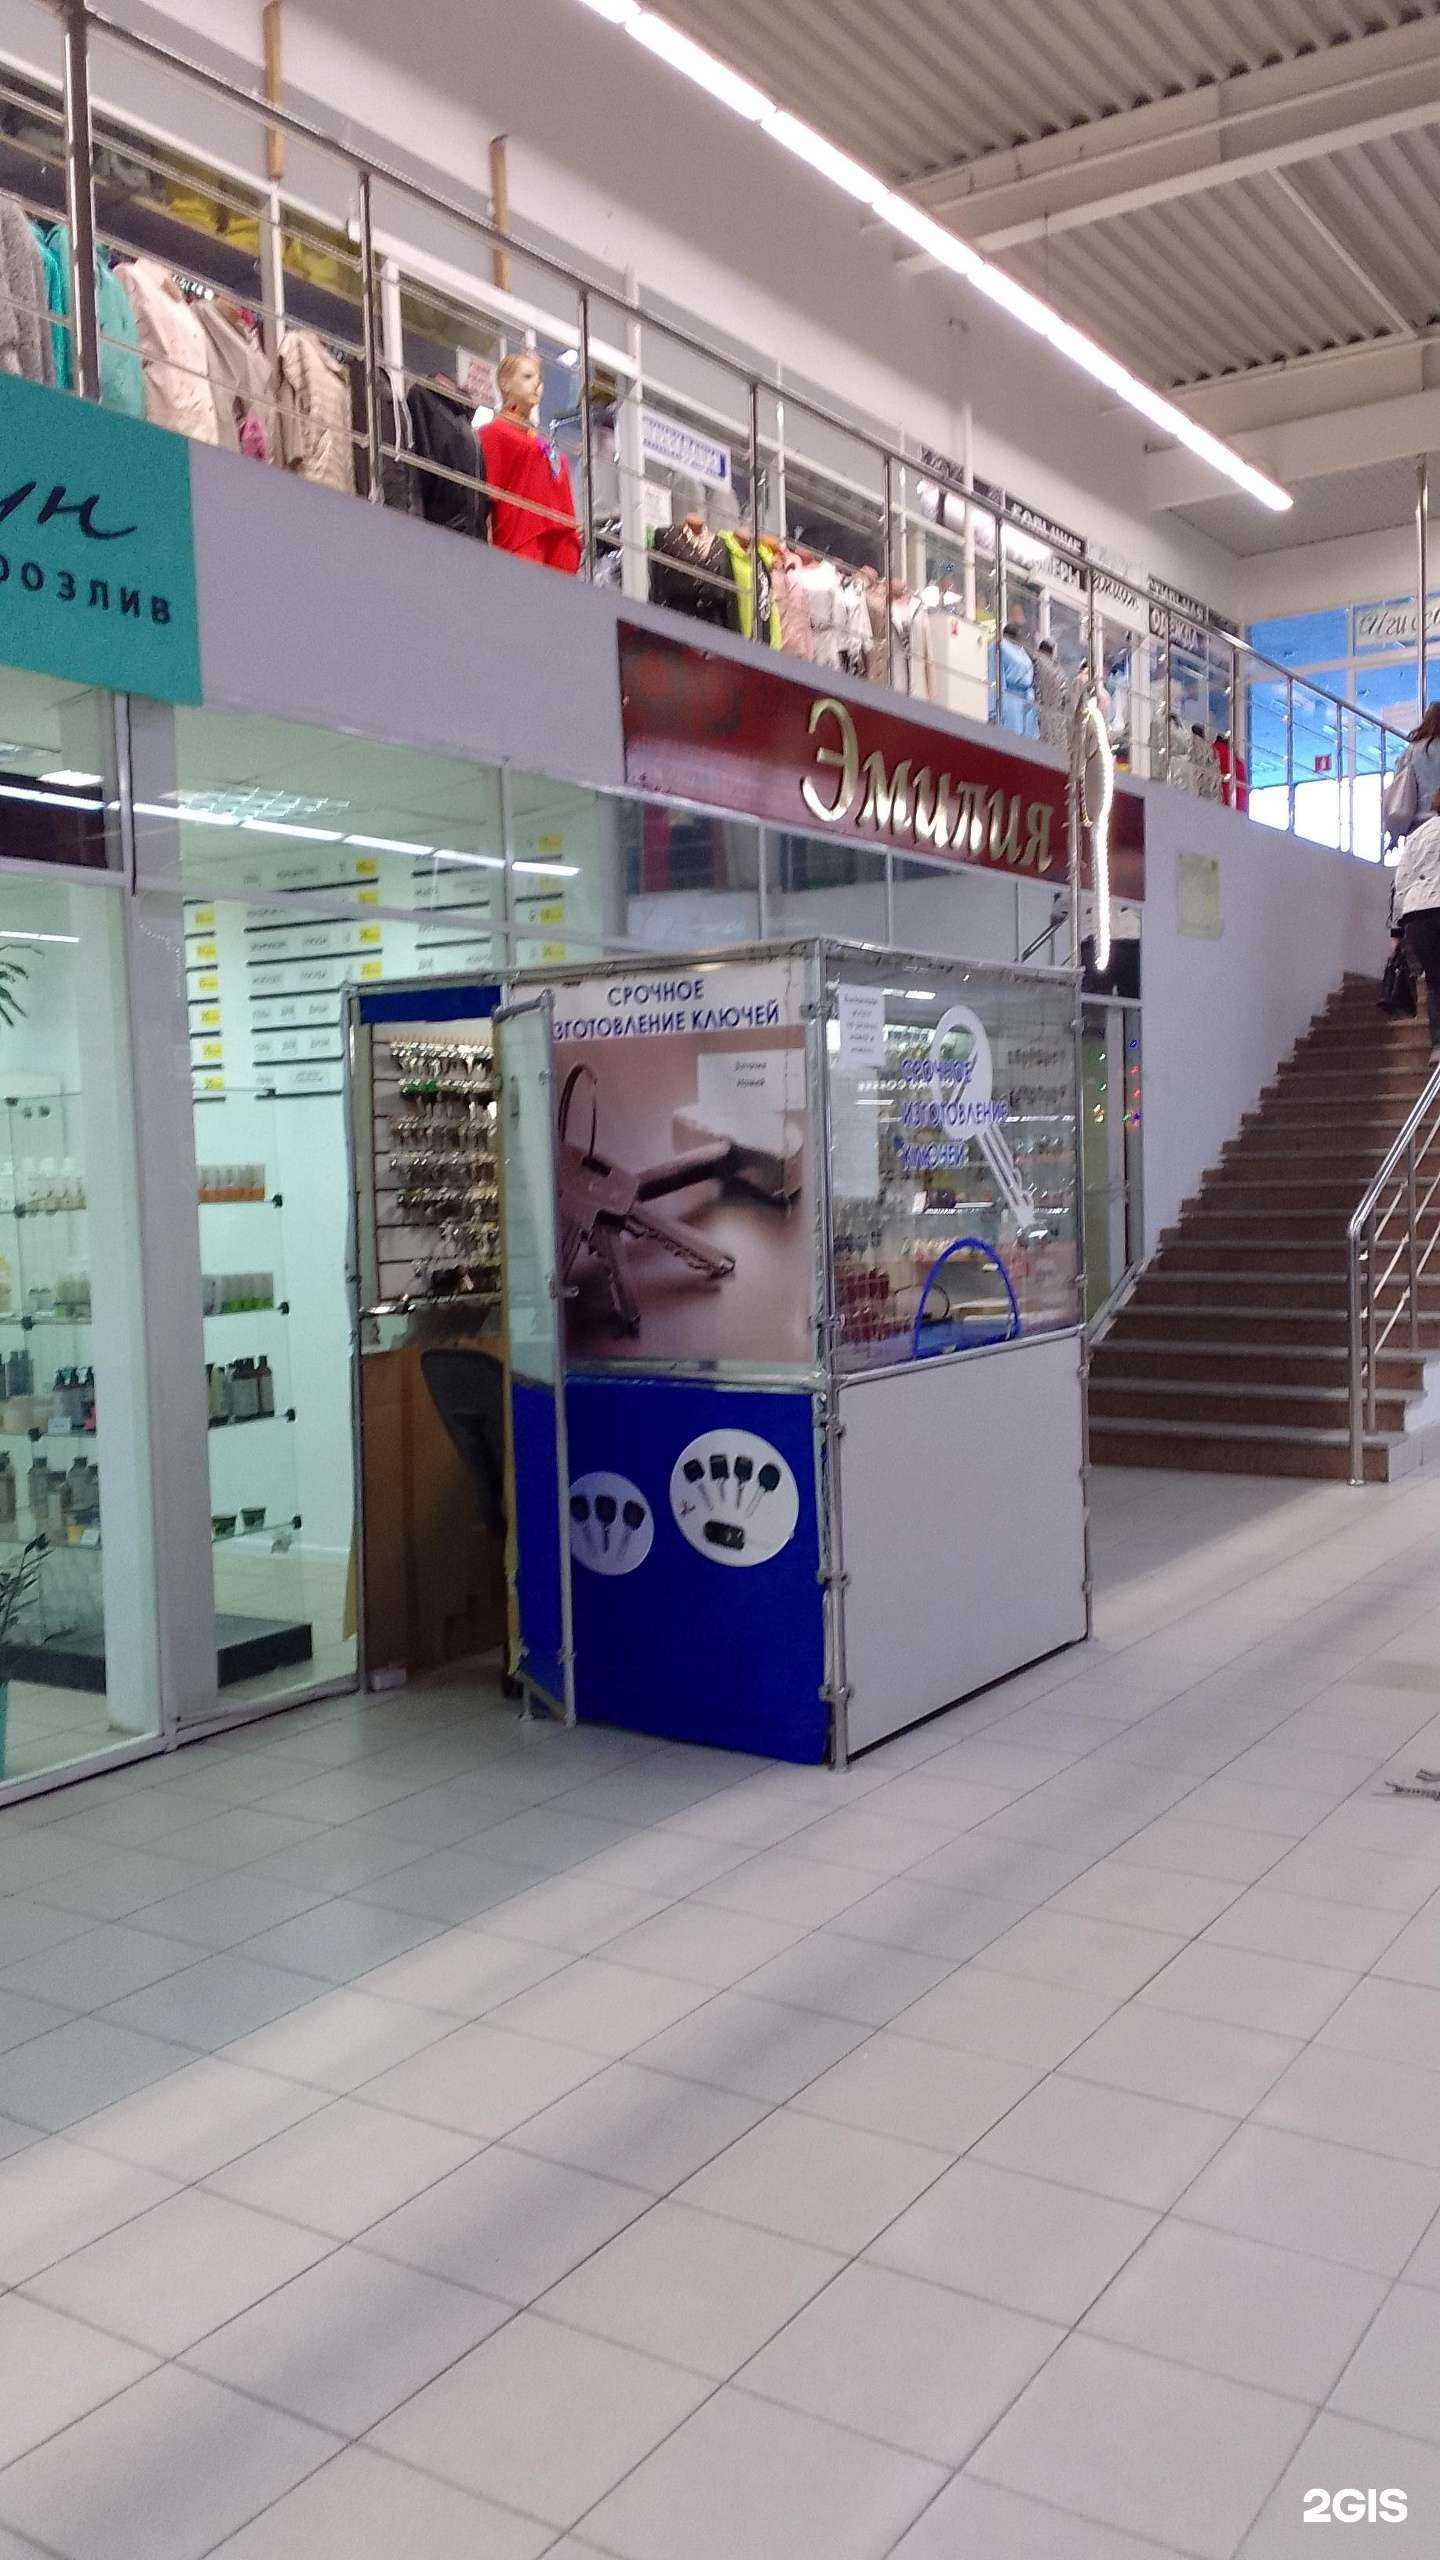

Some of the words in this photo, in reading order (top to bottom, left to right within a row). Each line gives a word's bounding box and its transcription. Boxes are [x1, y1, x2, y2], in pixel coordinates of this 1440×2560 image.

[801, 698, 1054, 873] Эмилия
[607, 979, 704, 1007] СРОЧНОЕ
[553, 1010, 687, 1040] ЗГОТОВЛЕНИЕ
[692, 1000, 779, 1030] КЛЮЧЕЙ
[902, 1059, 972, 1083] СРОЧНОЕ
[903, 1101, 1008, 1126] ИЗГОТОВЛЕНИЕ
